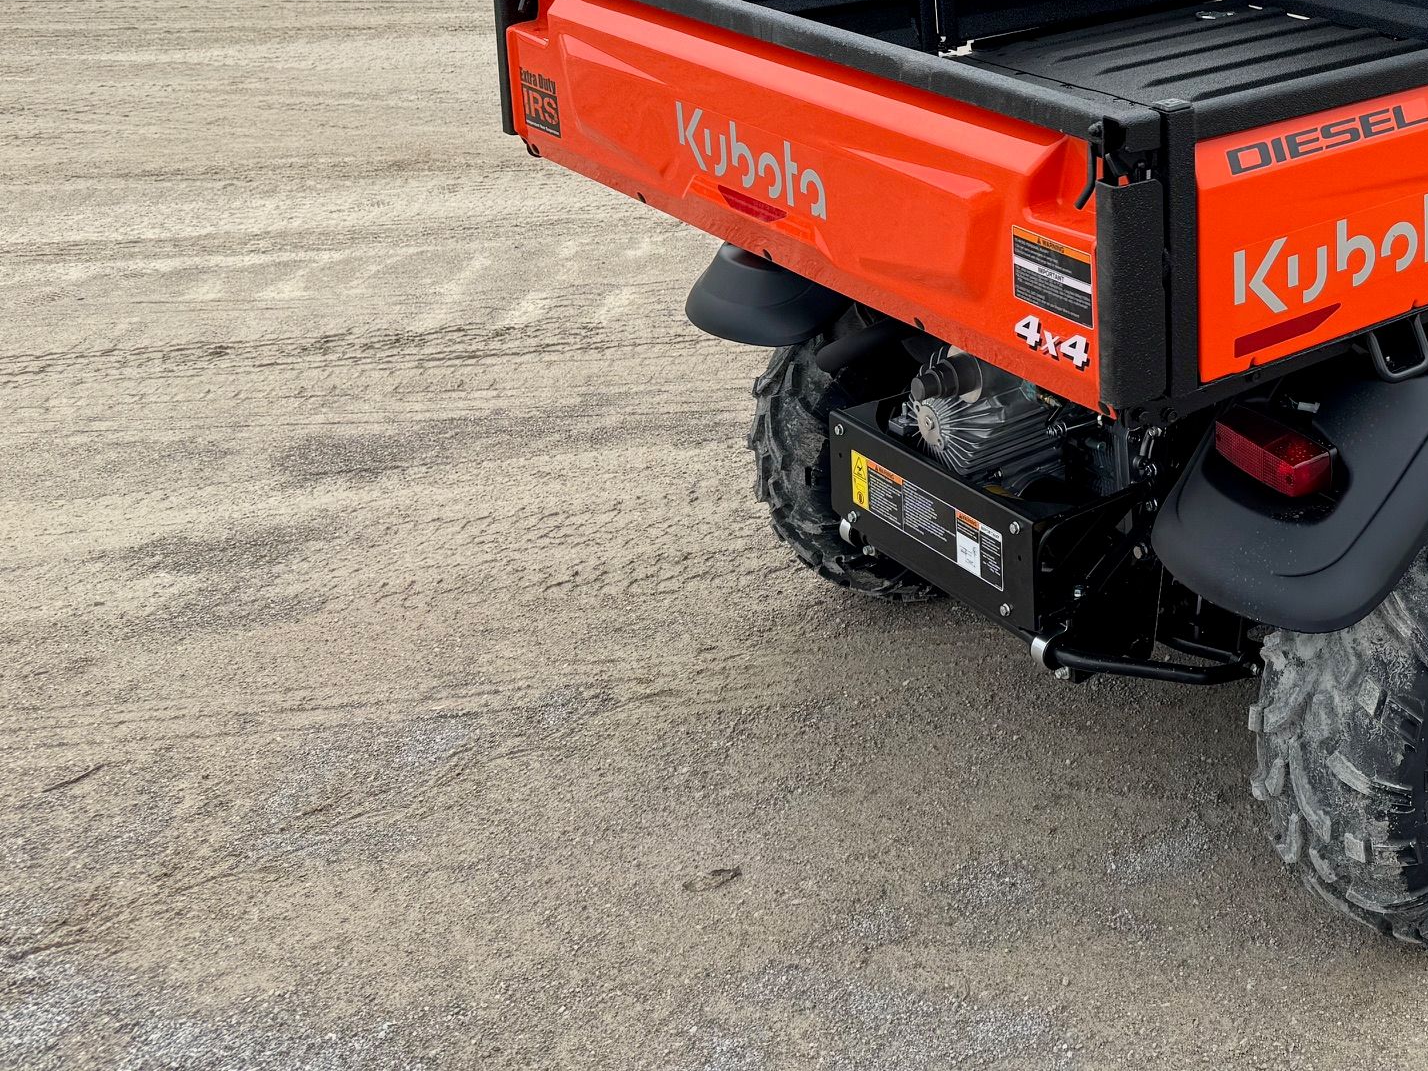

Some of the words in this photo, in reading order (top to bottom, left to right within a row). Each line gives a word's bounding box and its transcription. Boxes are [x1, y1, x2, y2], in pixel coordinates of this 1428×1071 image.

[522, 87, 559, 125] IRS
[675, 100, 827, 221] Kubota
[1013, 314, 1090, 370] 4x4
